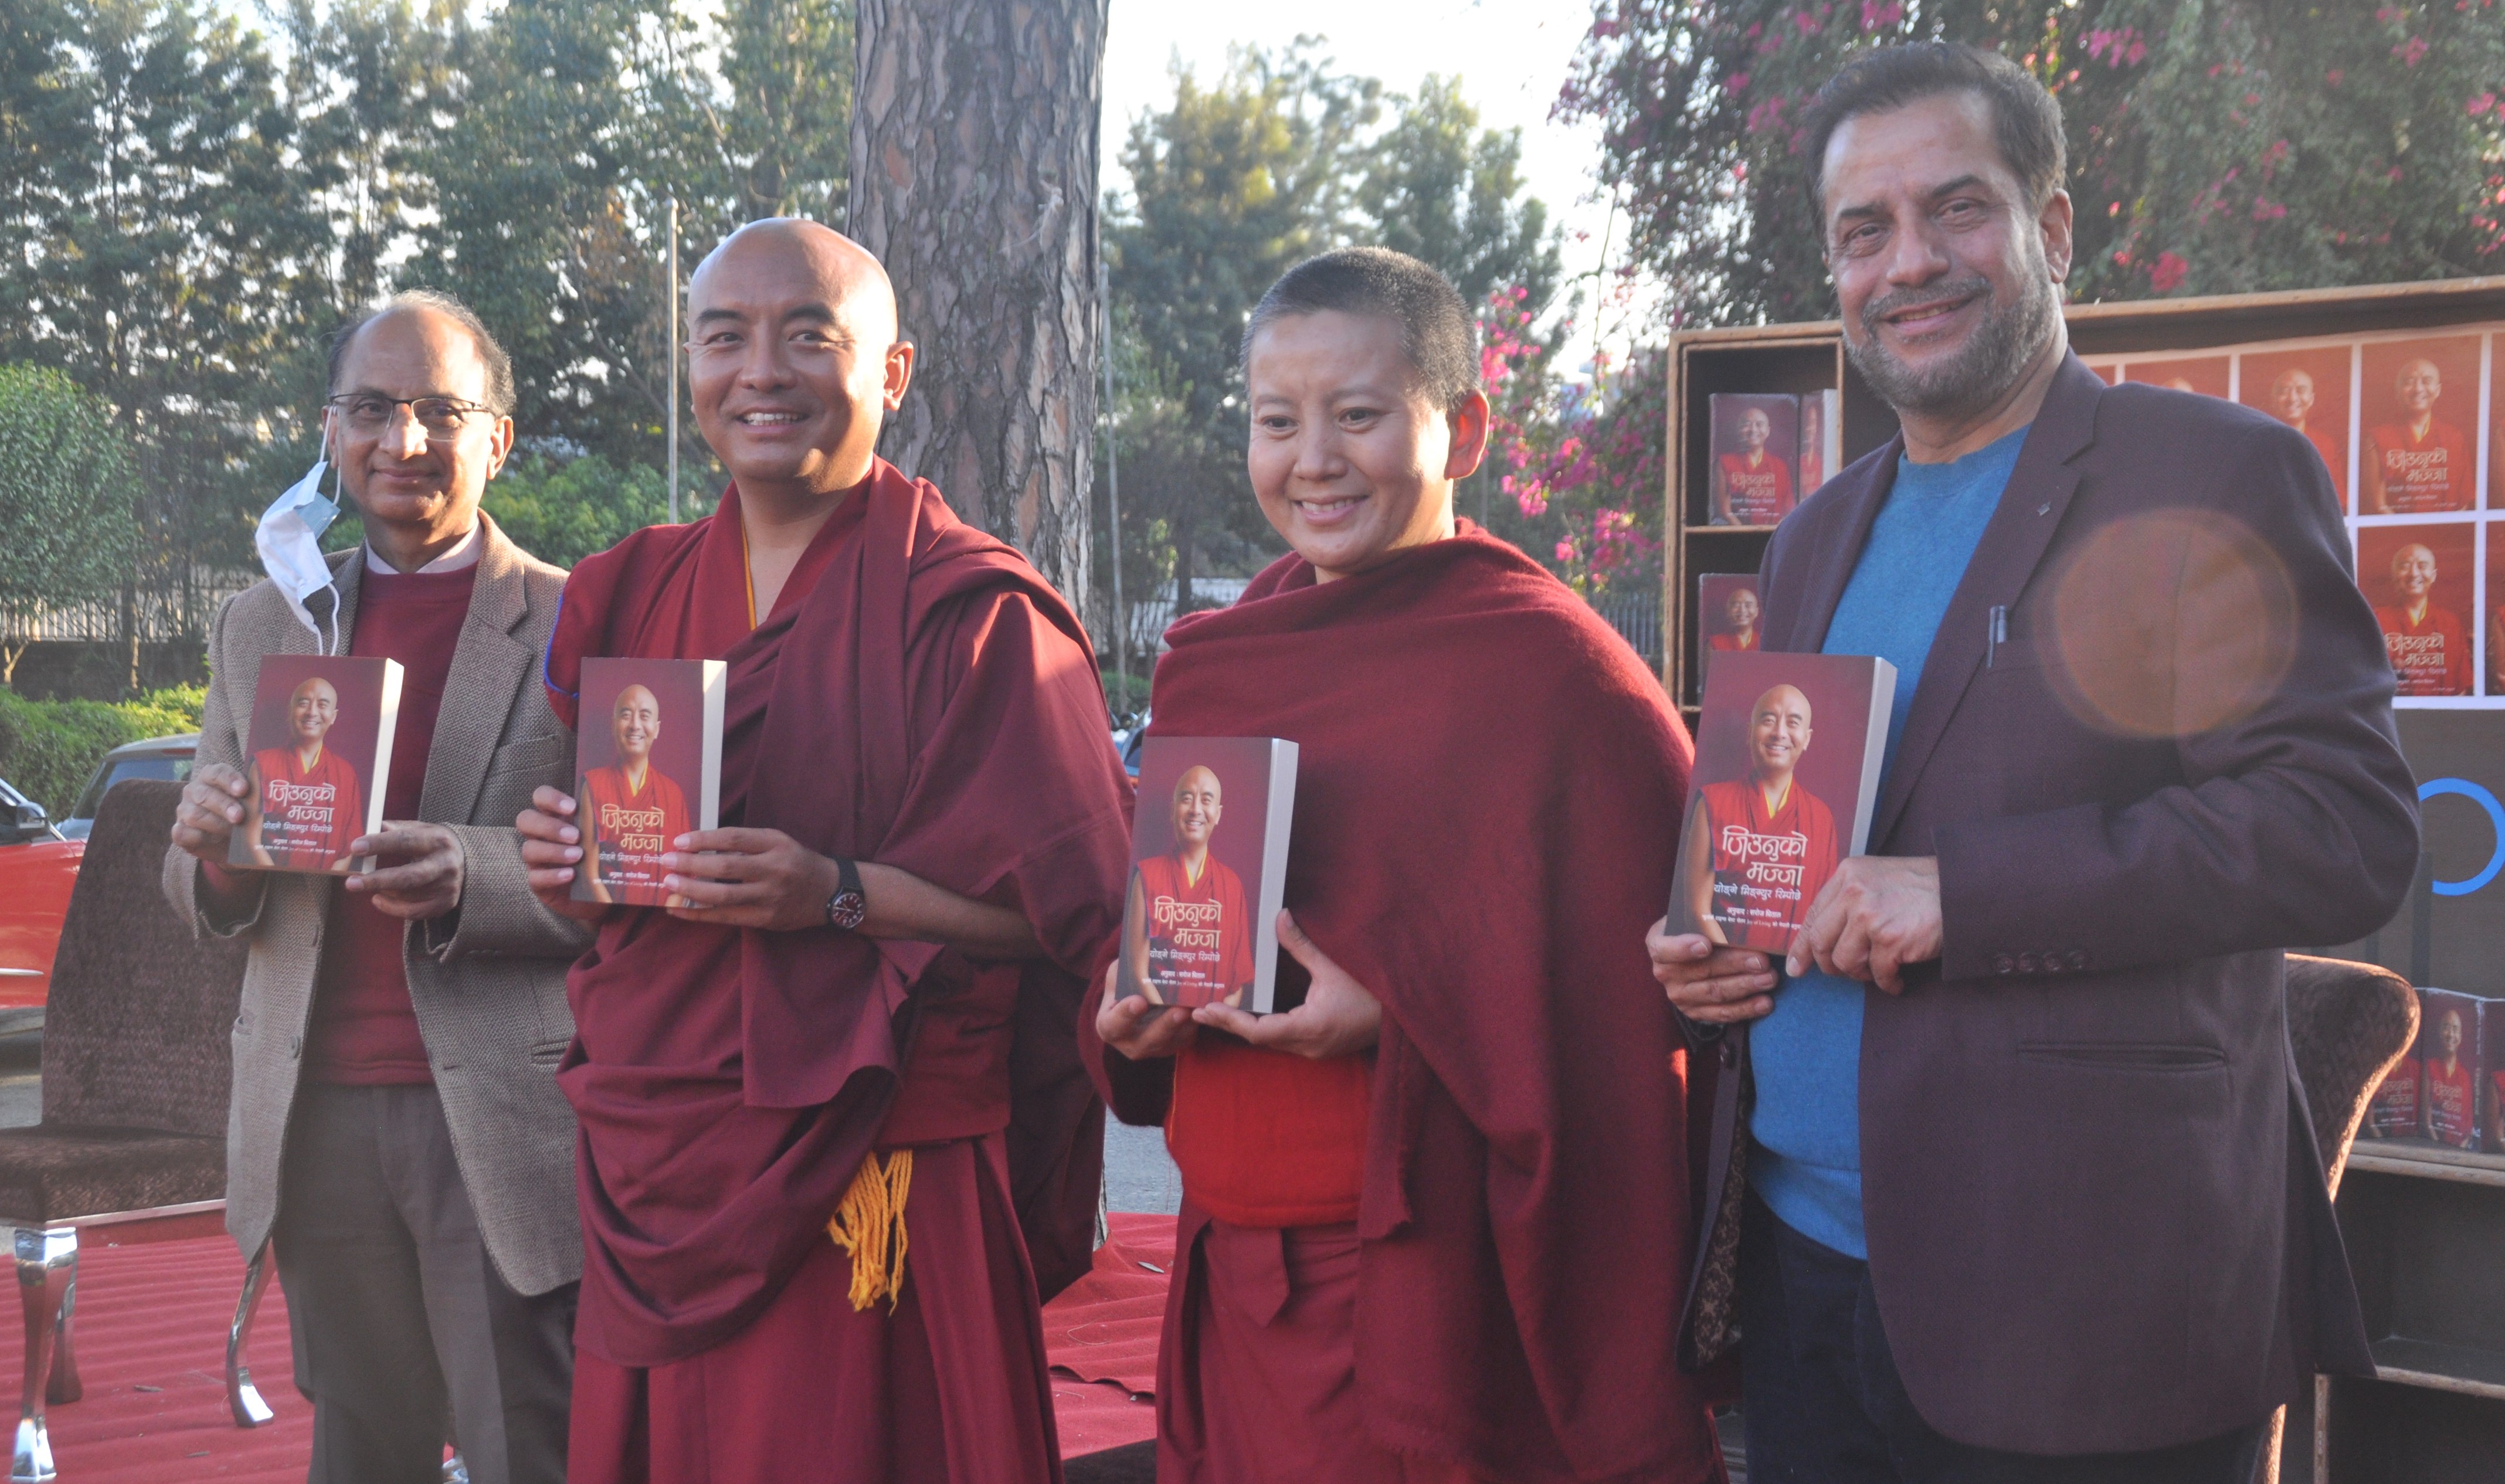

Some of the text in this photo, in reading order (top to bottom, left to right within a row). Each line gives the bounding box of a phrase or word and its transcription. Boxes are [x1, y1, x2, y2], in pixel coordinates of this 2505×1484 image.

[269, 779, 336, 807] जिउनुको
[287, 805, 335, 823] मज्जा
[601, 803, 665, 834] जिउनुको
[620, 833, 665, 851] मज्जा
[1722, 825, 1808, 864] जिउनुको
[1746, 861, 1805, 887] मज्जा
[1155, 895, 1223, 930] जिउनुको
[1174, 928, 1221, 949] मज्जा
